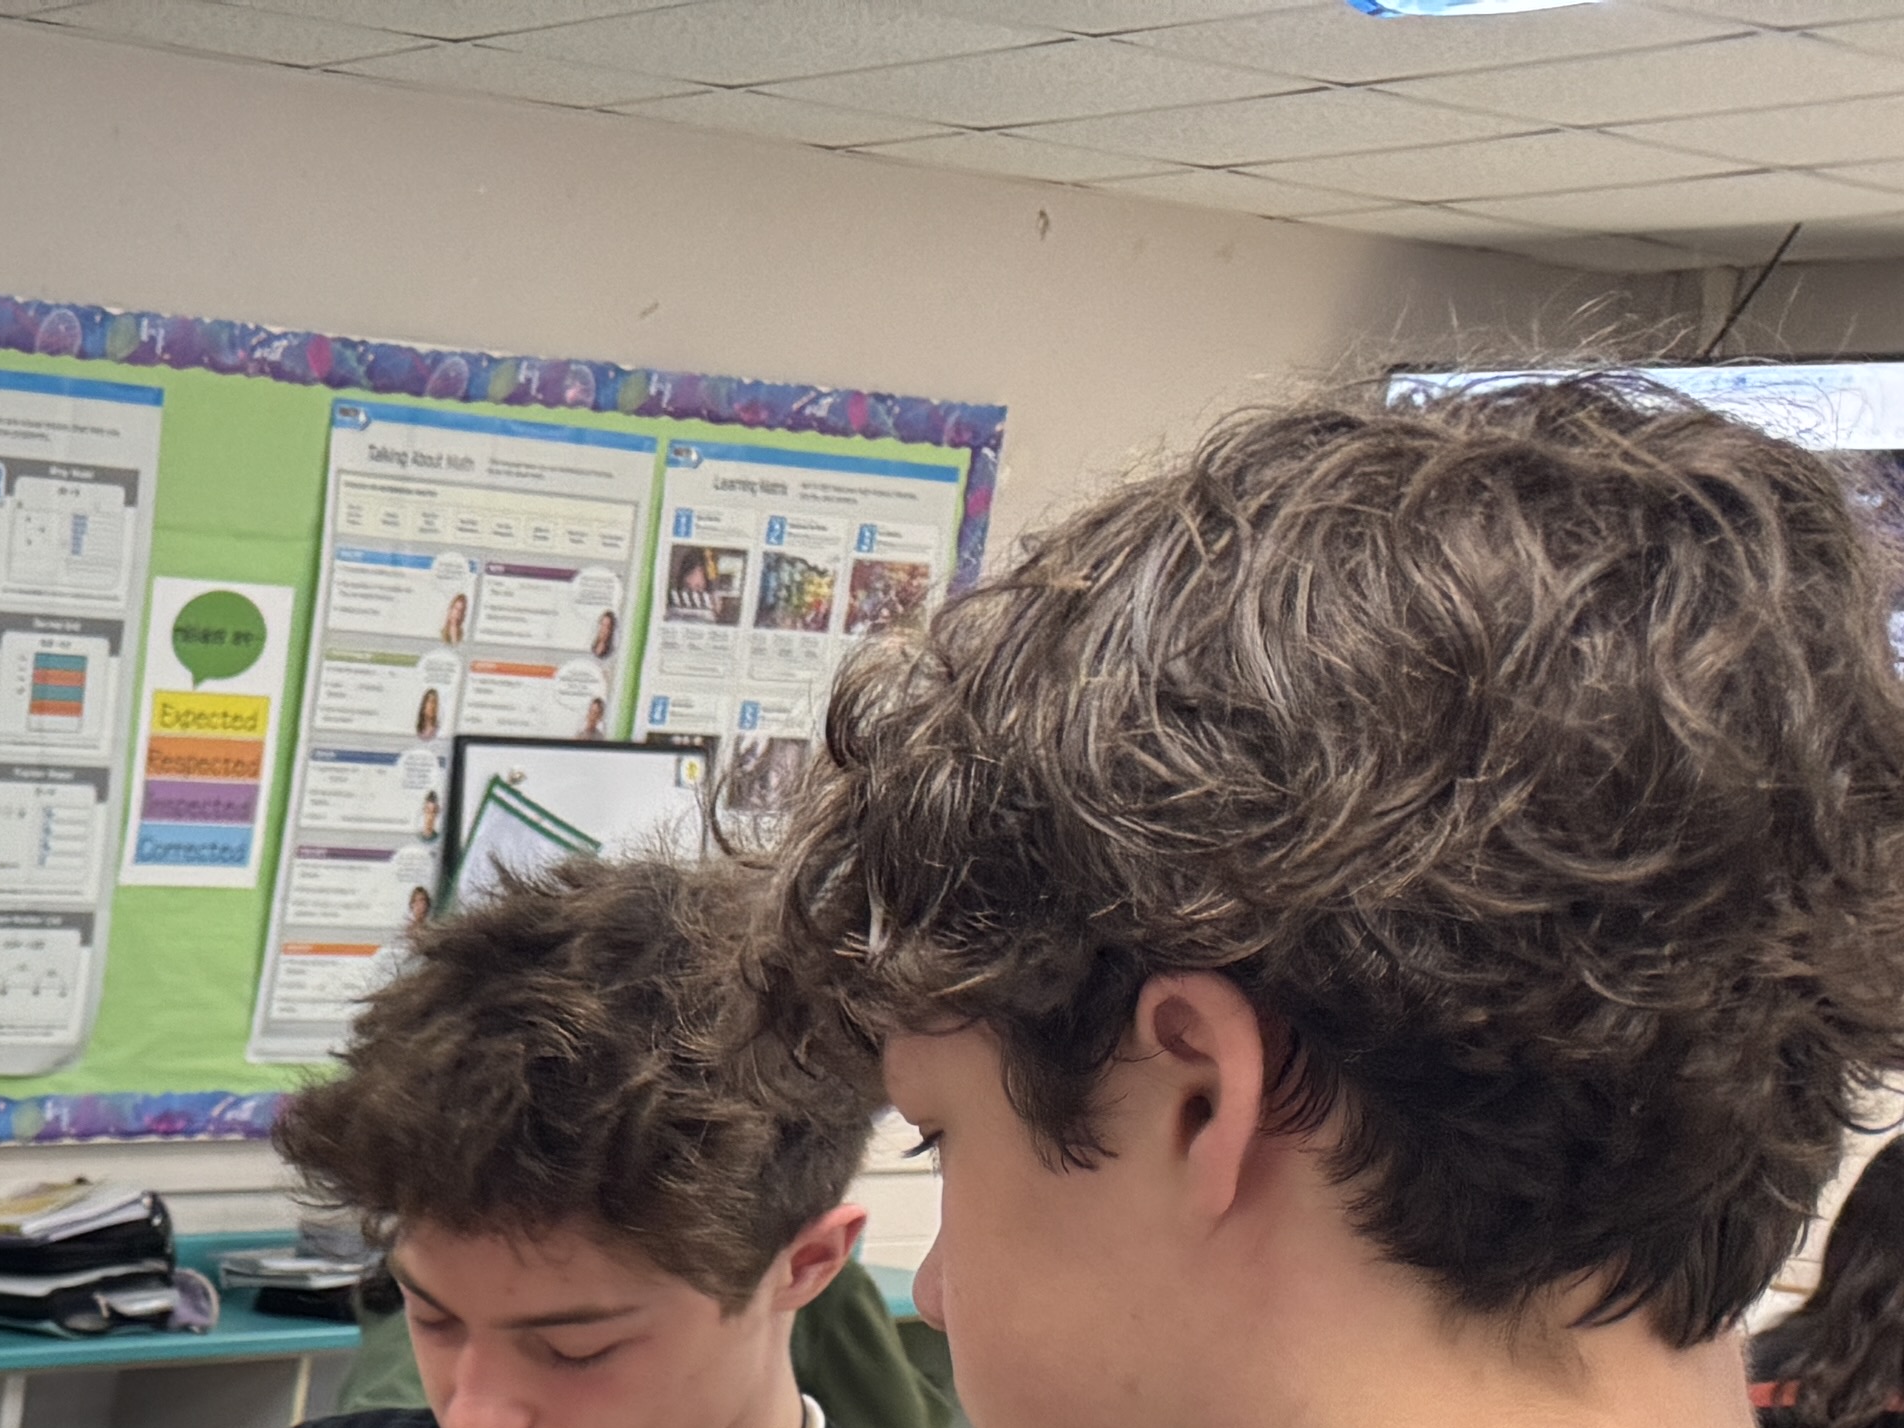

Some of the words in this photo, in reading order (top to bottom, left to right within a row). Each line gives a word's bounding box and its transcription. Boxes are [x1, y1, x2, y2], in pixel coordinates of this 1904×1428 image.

[368, 443, 409, 469] Talking
[412, 448, 443, 469] About
[446, 454, 475, 472] Math
[160, 703, 259, 731] Expected
[148, 748, 259, 778] Respected
[136, 836, 248, 864] Corrected
